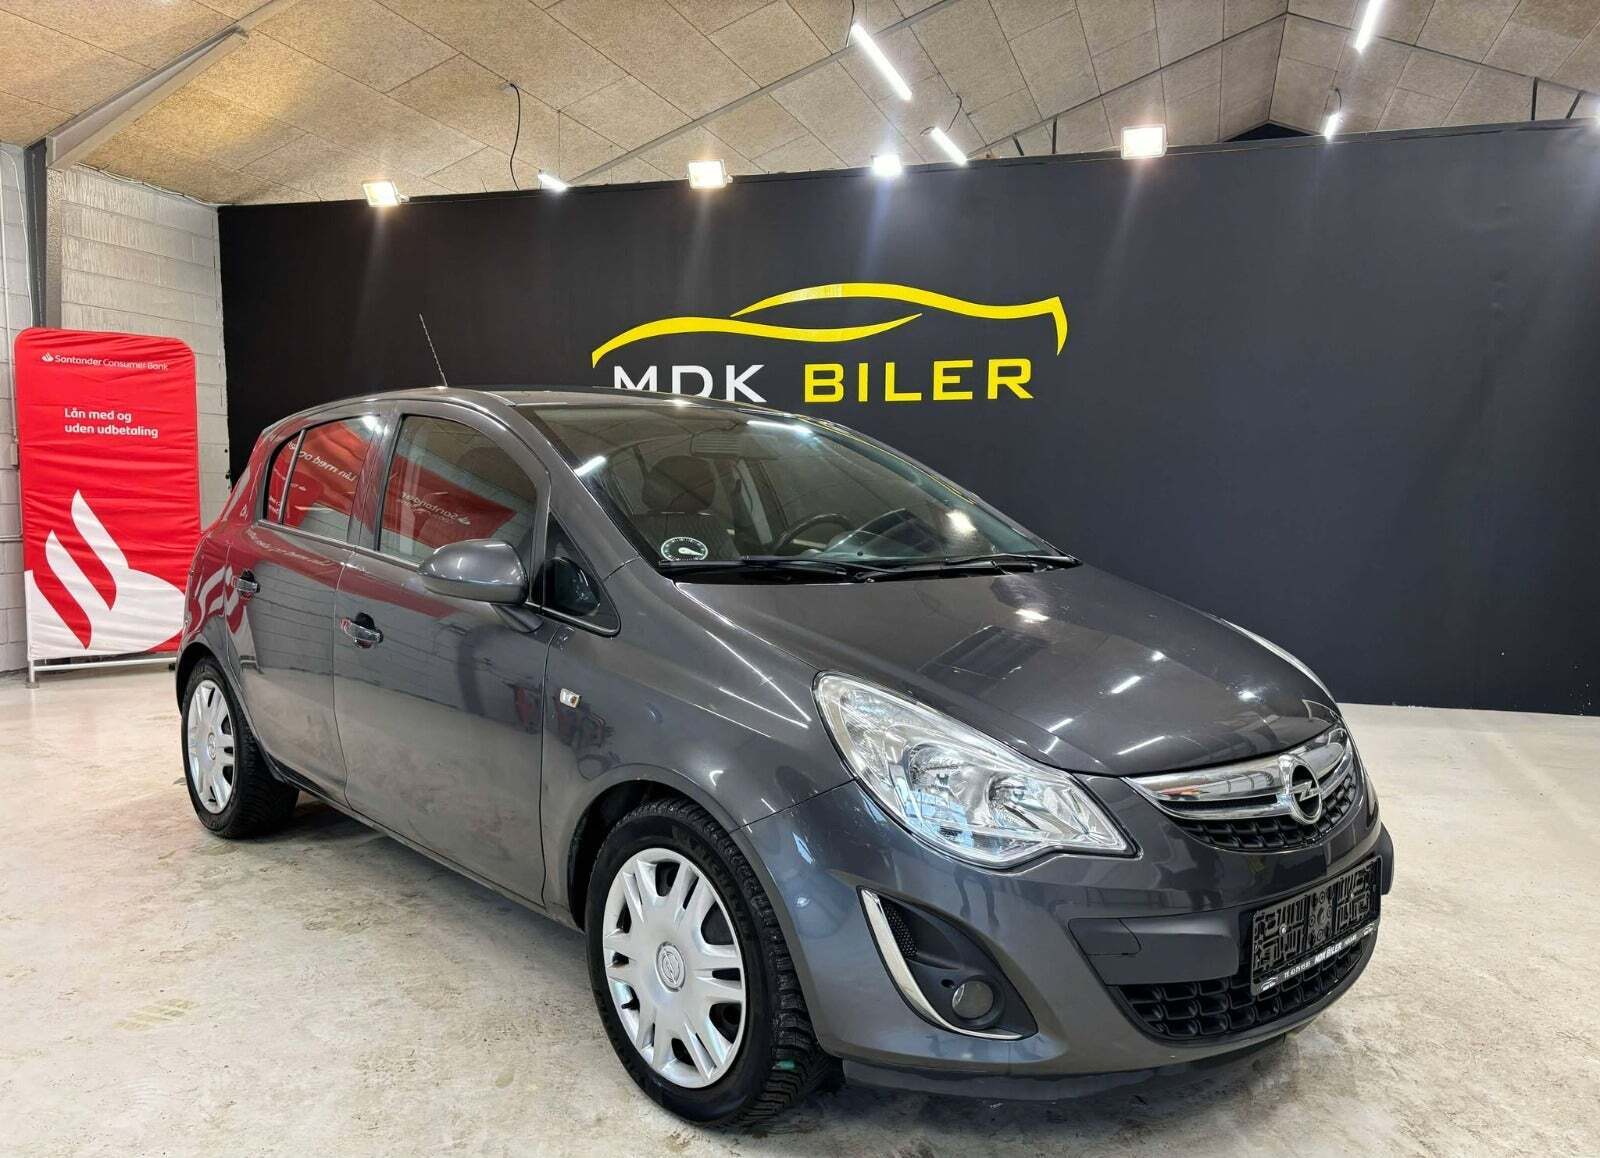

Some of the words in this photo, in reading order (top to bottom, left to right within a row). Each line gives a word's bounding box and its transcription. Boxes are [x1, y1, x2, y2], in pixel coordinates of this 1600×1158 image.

[55, 354, 101, 366] Santander
[103, 358, 147, 369] Consumer
[147, 360, 169, 371] Bank
[613, 364, 767, 403] MDK
[804, 358, 1035, 403] BILER
[64, 407, 86, 419] Lån
[88, 409, 115, 421] med
[117, 411, 132, 423] og
[64, 423, 95, 434] uden
[97, 424, 159, 439] udbetaling
